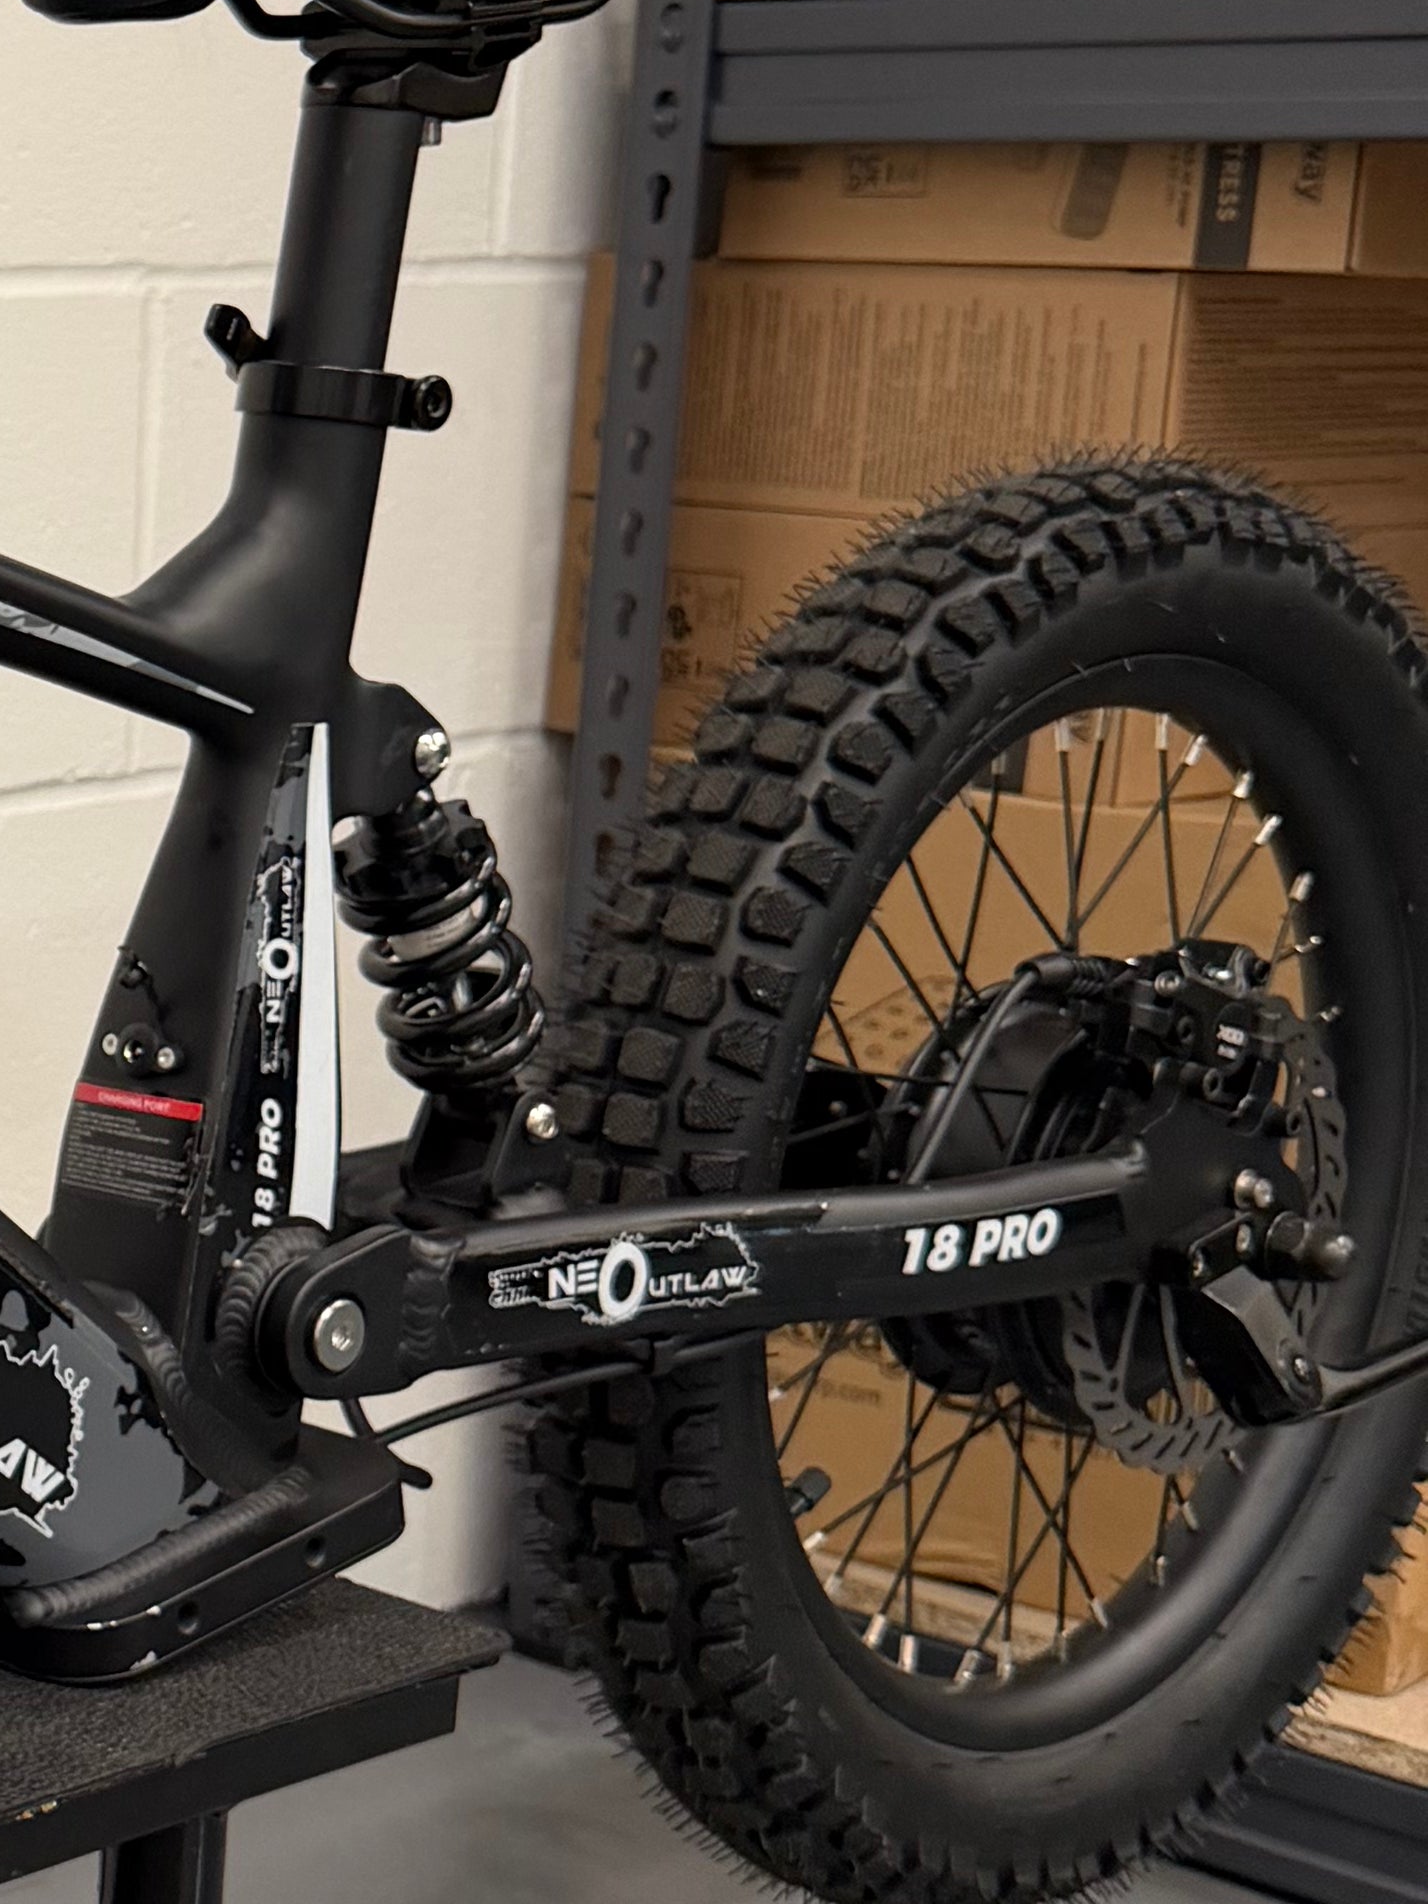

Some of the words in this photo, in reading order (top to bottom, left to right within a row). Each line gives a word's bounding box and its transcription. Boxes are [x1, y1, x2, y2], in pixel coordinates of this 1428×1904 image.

[257, 1097, 282, 1179] PRO
[901, 1225, 965, 1275] 18
[968, 1209, 1062, 1268] PRO
